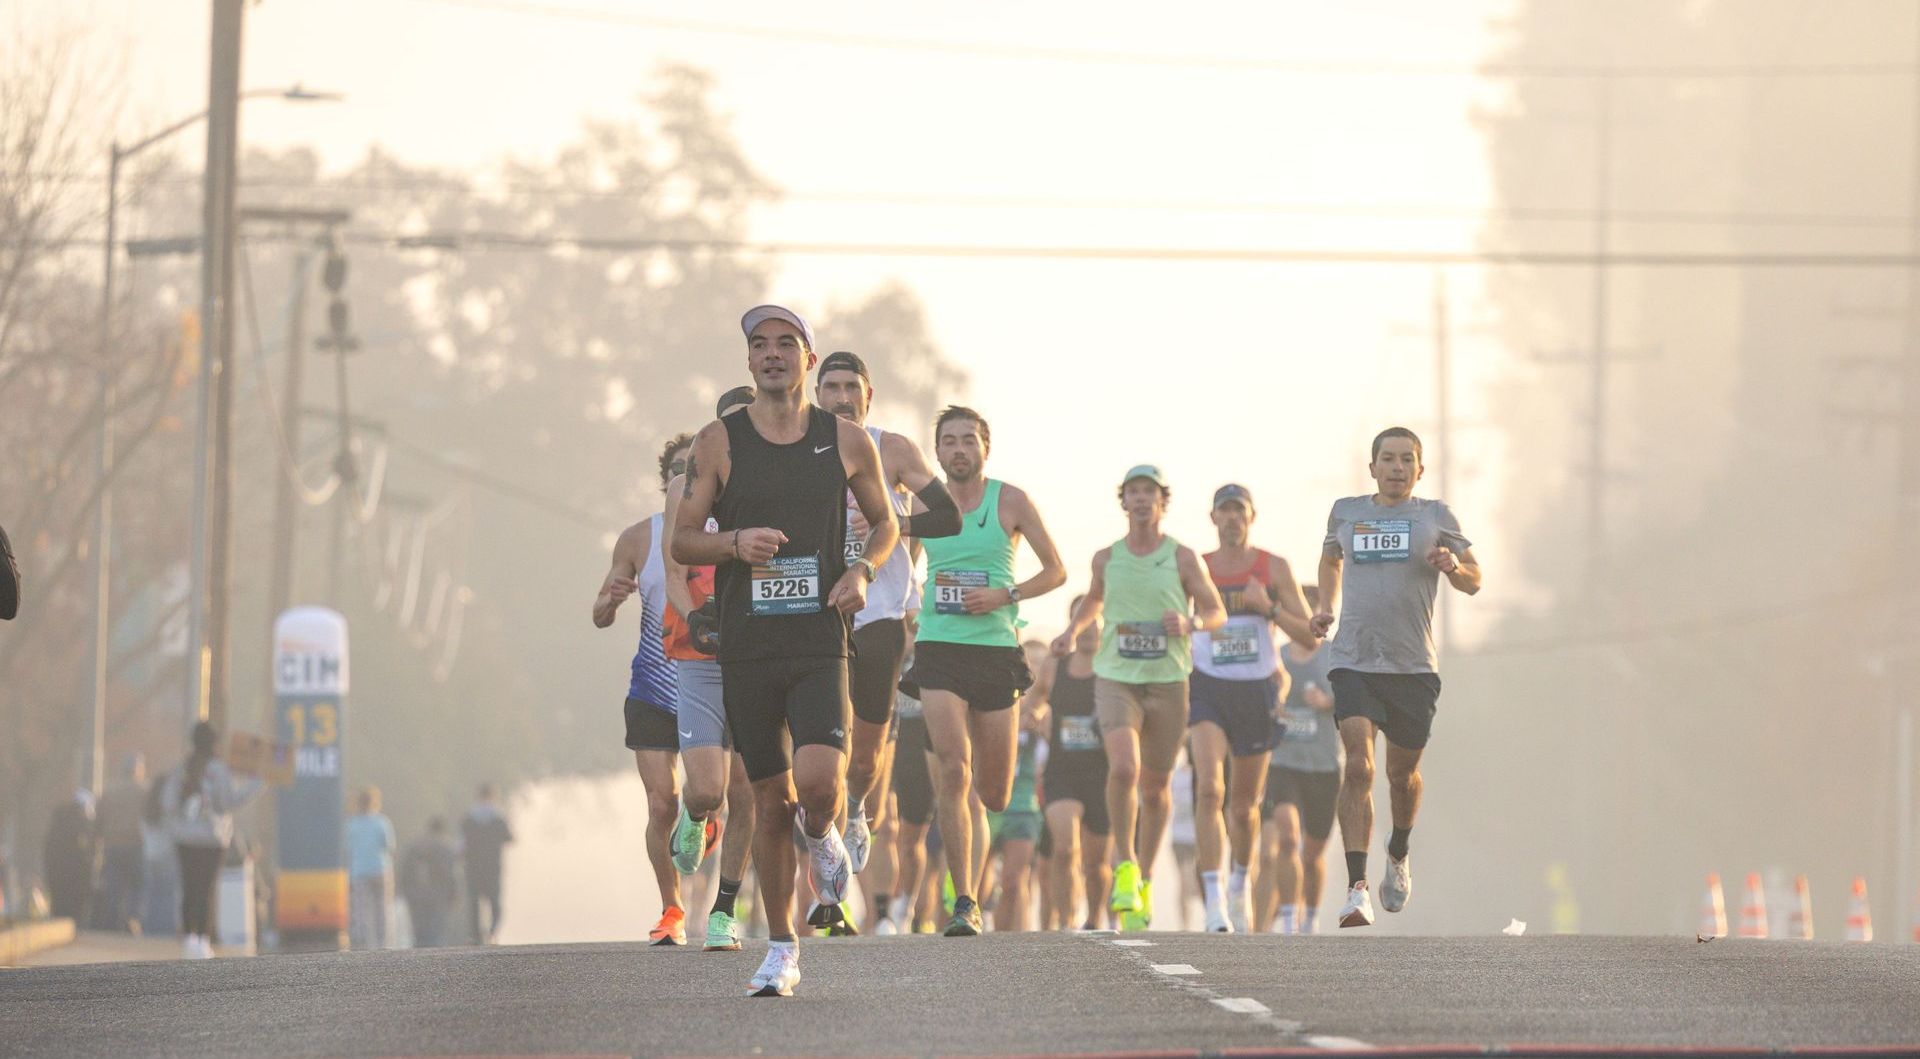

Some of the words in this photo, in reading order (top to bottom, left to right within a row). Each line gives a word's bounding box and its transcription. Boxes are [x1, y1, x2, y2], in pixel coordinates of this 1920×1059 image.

[1361, 534, 1401, 550] 1169
[770, 563, 817, 571] INTERNATIONAL
[783, 569, 818, 577] MARATHON
[760, 578, 810, 599] 5226
[786, 601, 820, 609] MARATHON
[281, 655, 340, 685] CIM
[287, 703, 337, 746] 13
